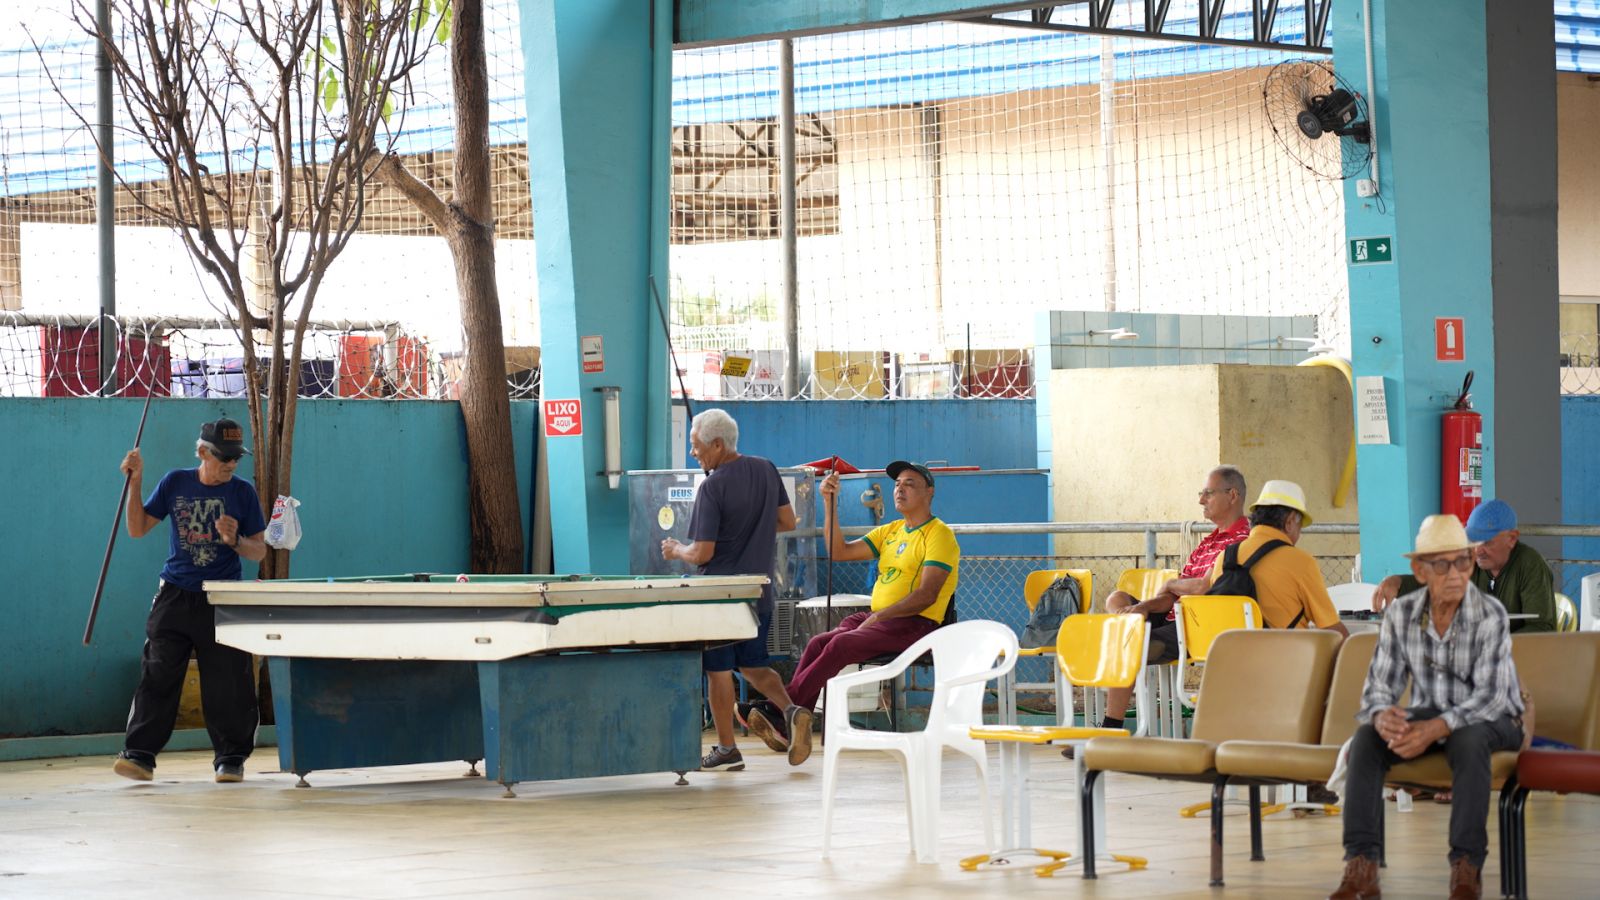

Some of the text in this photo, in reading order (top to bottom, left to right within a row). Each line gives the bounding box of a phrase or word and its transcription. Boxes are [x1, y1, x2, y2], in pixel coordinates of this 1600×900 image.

[547, 402, 578, 415] LIXO
[556, 419, 571, 427] AQUI
[671, 489, 692, 497] DEUS
